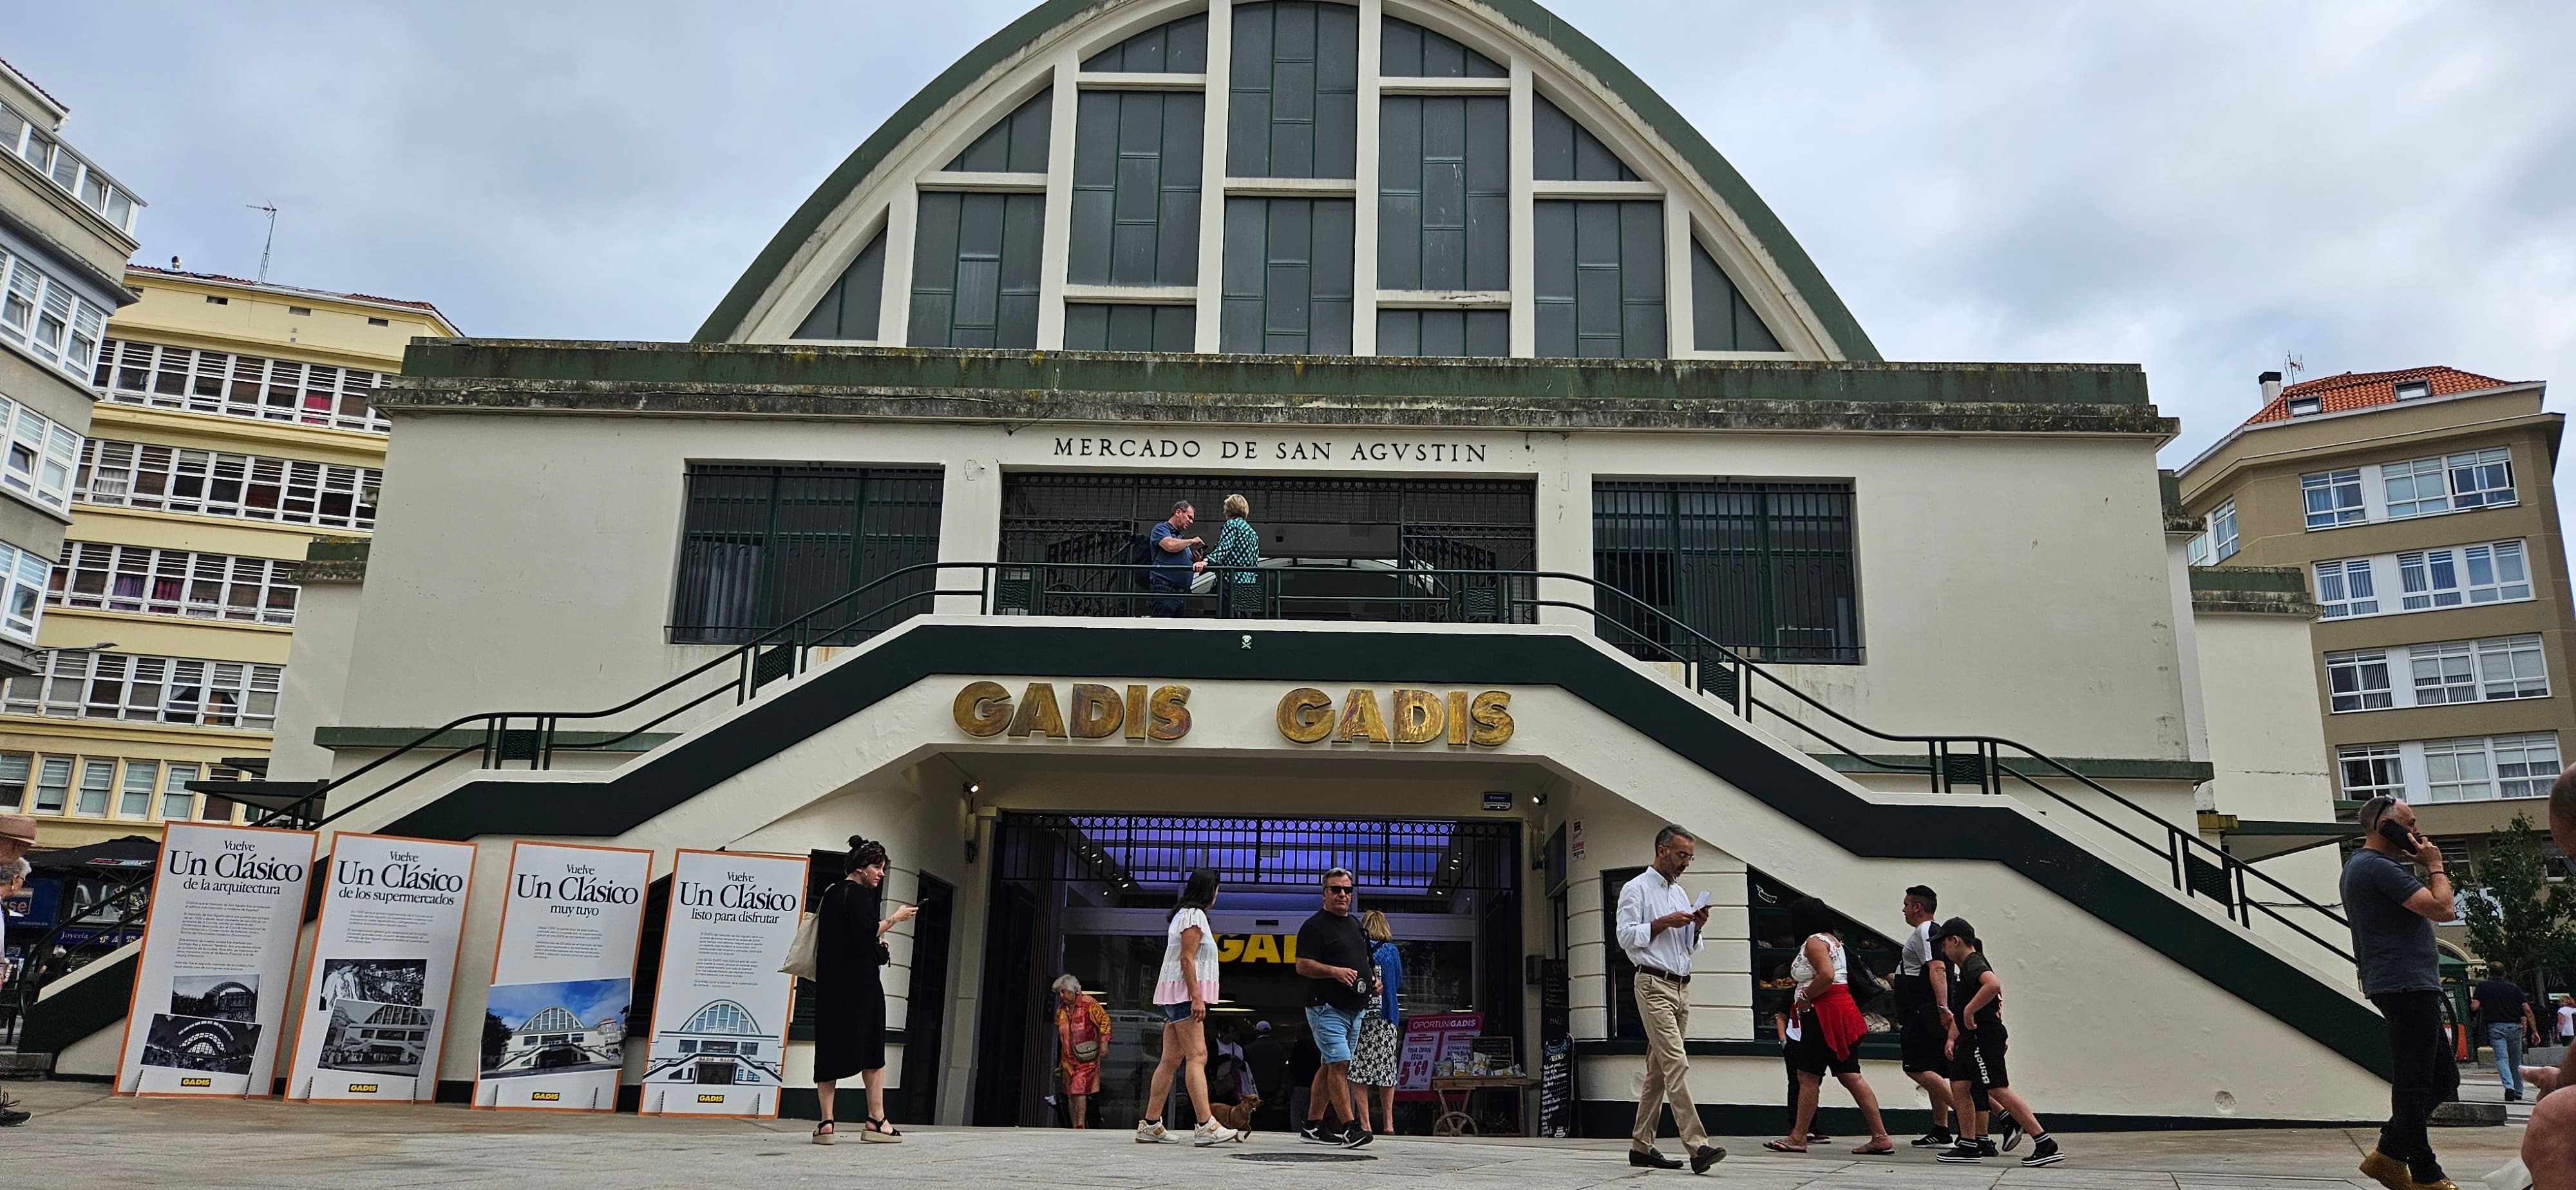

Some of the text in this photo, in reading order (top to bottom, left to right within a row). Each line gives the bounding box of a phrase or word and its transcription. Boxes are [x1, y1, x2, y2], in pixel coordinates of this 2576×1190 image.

[1054, 437, 1486, 462] MERCADO DE SAN AGVSTIN
[953, 681, 1515, 746] GADIS GADIS
[224, 840, 256, 852] Vuelve
[169, 849, 303, 883] Un Clásico
[390, 851, 419, 863] Vuelve
[338, 860, 463, 892] Un Clásico
[566, 864, 595, 876] Vuelve
[727, 871, 755, 883] Vuelve
[183, 878, 281, 896] de la arquitectura
[338, 887, 455, 905] de los supermercados
[517, 873, 639, 905] Un Clásico
[680, 882, 797, 912] Un Clásico
[550, 905, 600, 919] muy tuyo
[691, 907, 781, 924] listo para disfrutar
[1413, 1019, 1476, 1029] OPORTUNIGADIS
